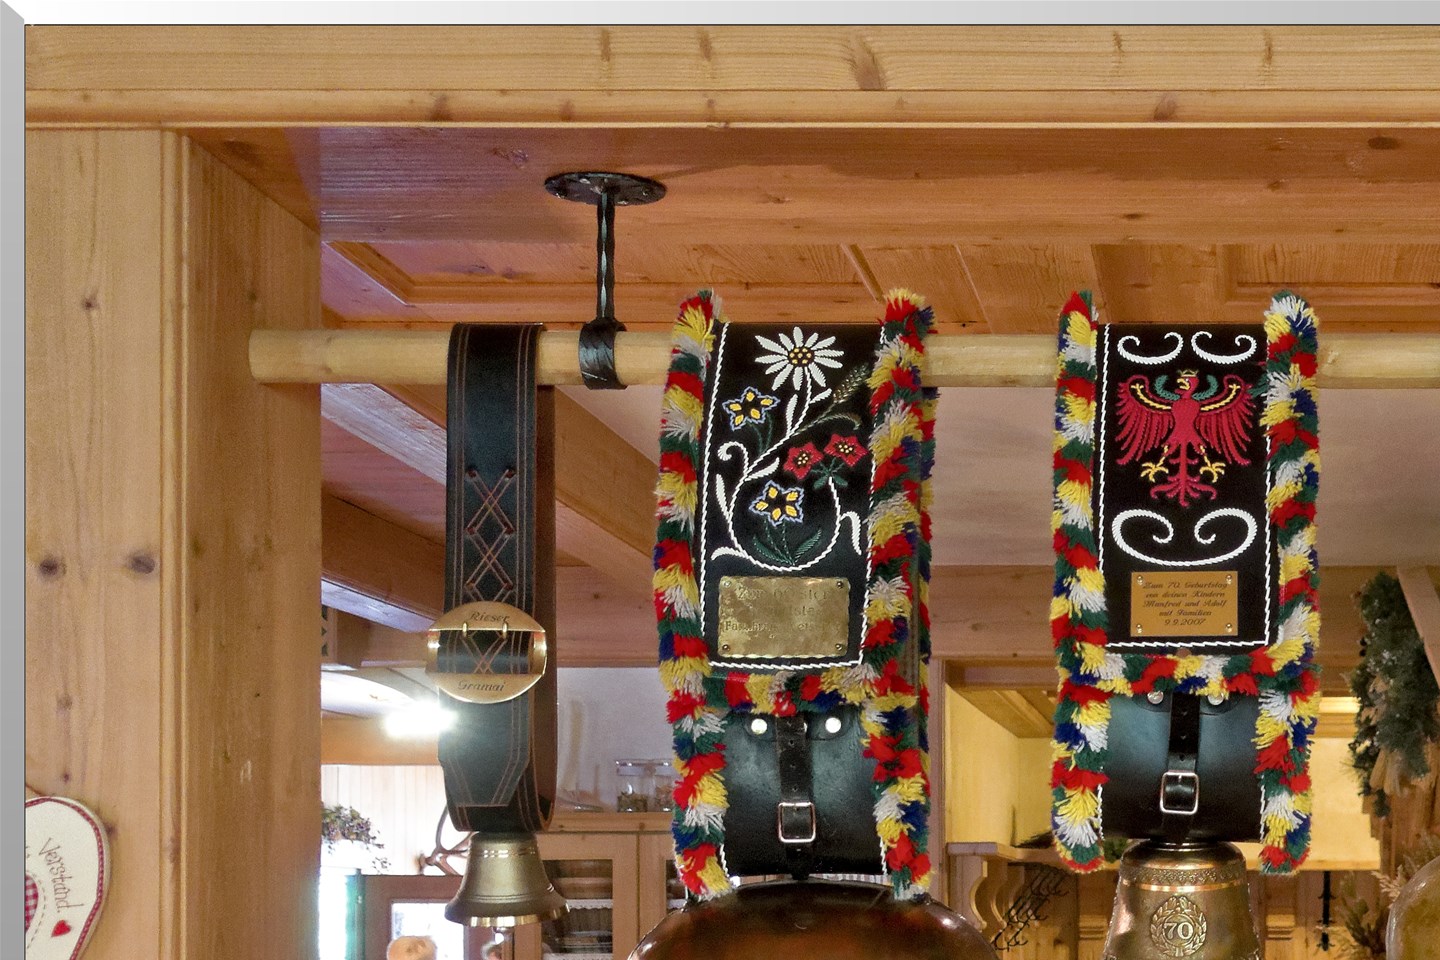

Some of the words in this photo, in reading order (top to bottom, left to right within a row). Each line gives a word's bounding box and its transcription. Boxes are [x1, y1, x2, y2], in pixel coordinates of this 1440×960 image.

[1192, 590, 1226, 598] Kindern
[469, 611, 511, 622] Rieser
[457, 680, 506, 692] Gramai
[1163, 921, 1194, 940] 70
